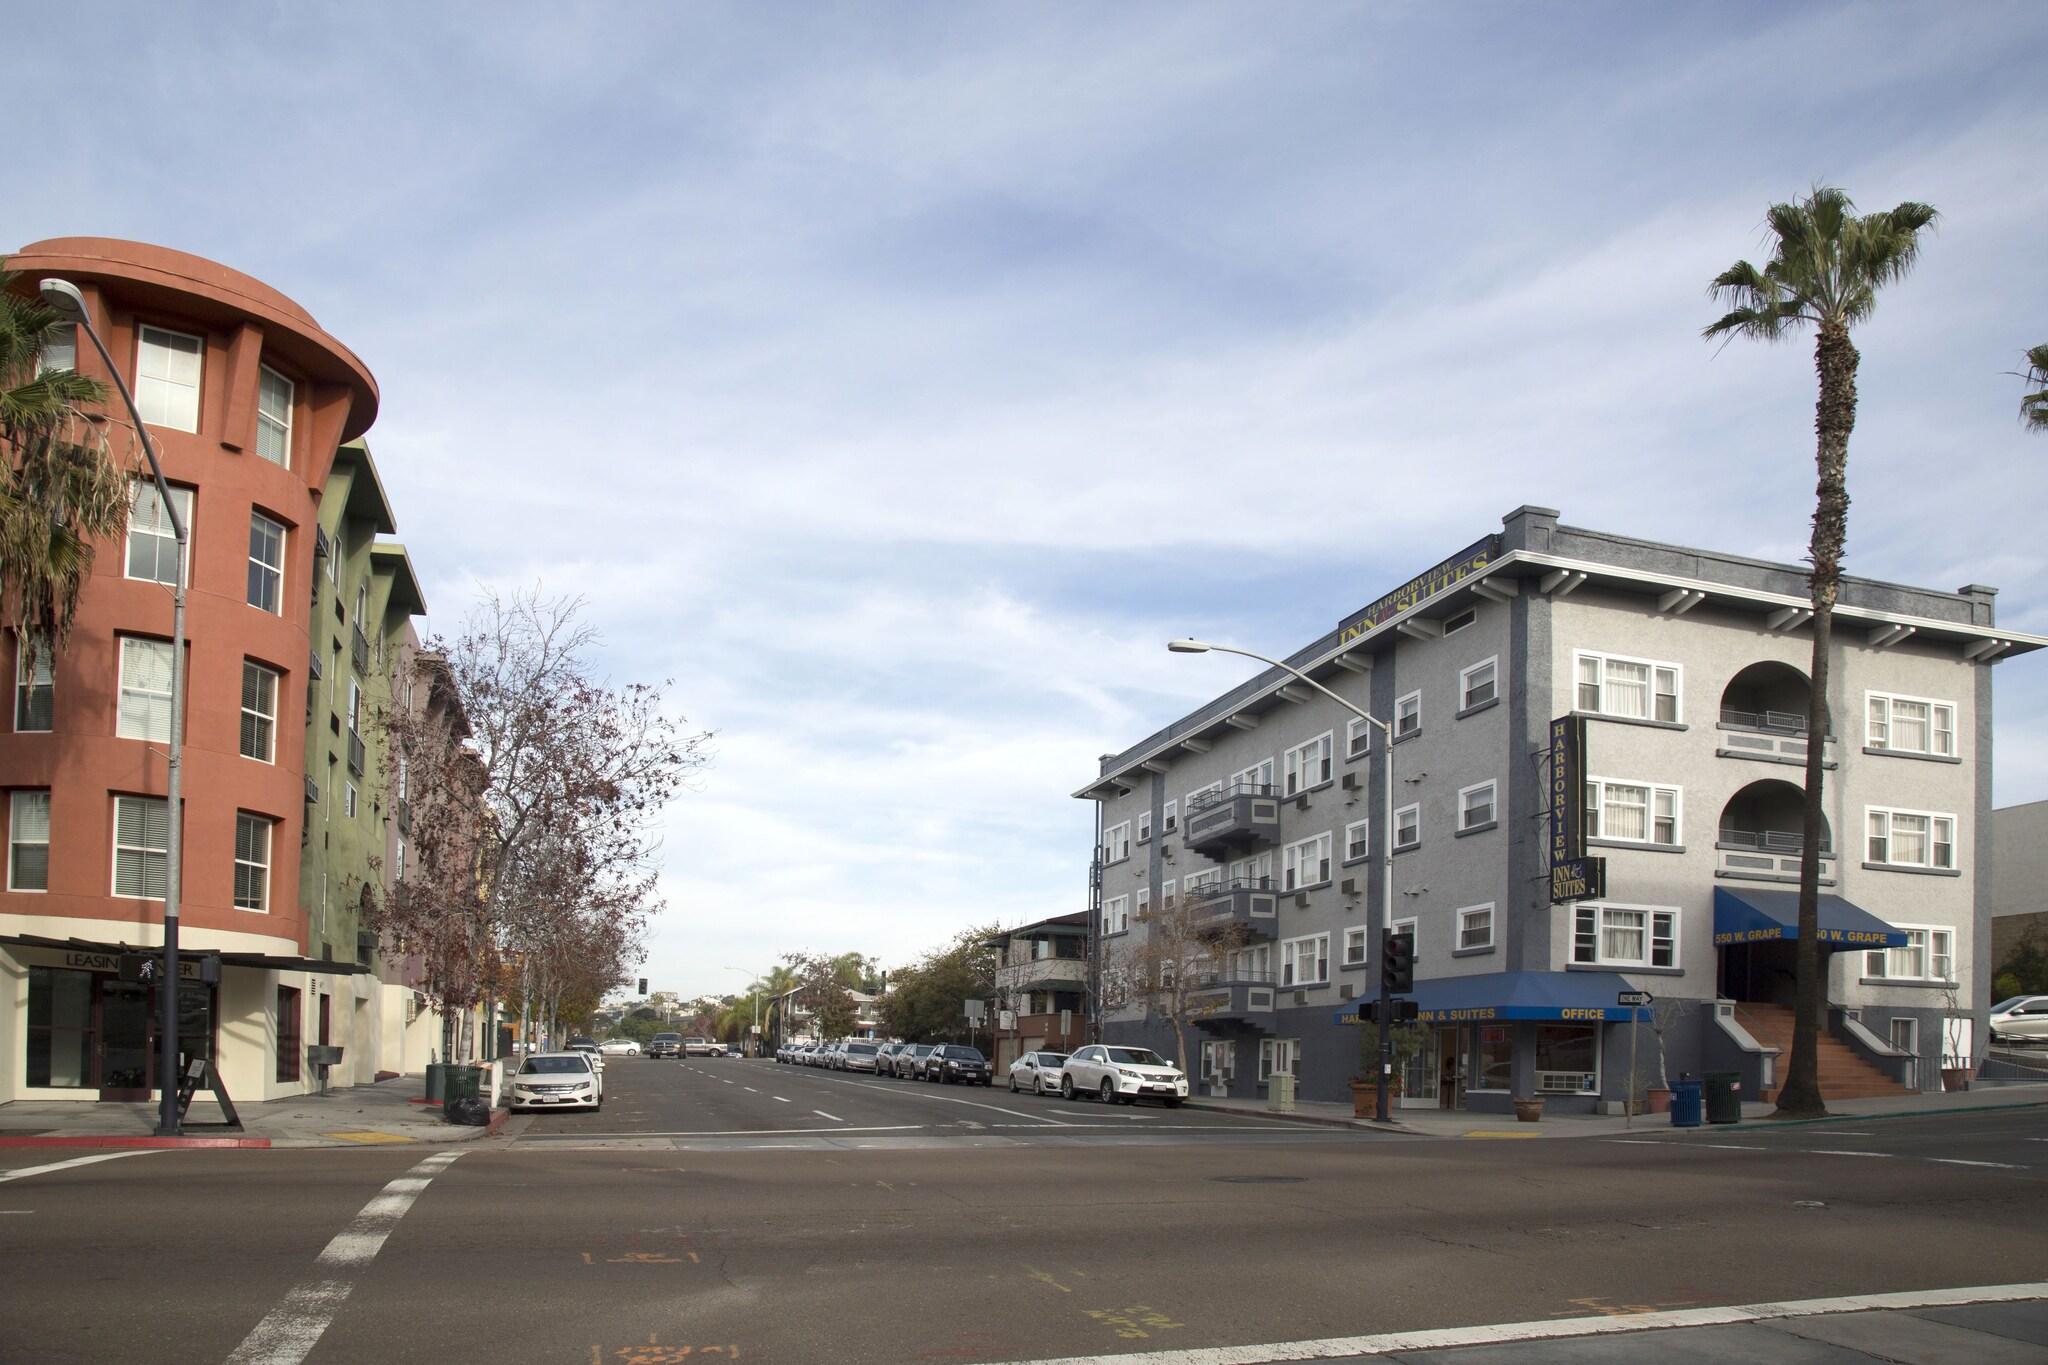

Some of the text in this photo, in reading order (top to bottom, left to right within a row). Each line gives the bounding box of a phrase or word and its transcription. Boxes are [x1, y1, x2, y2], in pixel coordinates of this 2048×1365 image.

[1340, 613, 1377, 646] INN
[1396, 549, 1489, 612] SUITES
[1367, 559, 1454, 617] HARBORVIEW
[1553, 724, 1566, 862] HARBORVIEW
[1553, 862, 1583, 883] INN &
[1553, 878, 1585, 899] SUITES
[1715, 927, 1782, 944] 550 W. GRAPE
[1816, 928, 1887, 944] 50 W. GRAPE
[66, 953, 119, 969] LEASIN
[1415, 1008, 1496, 1022] NN & SUITES
[1561, 1008, 1605, 1020] OFFICE
